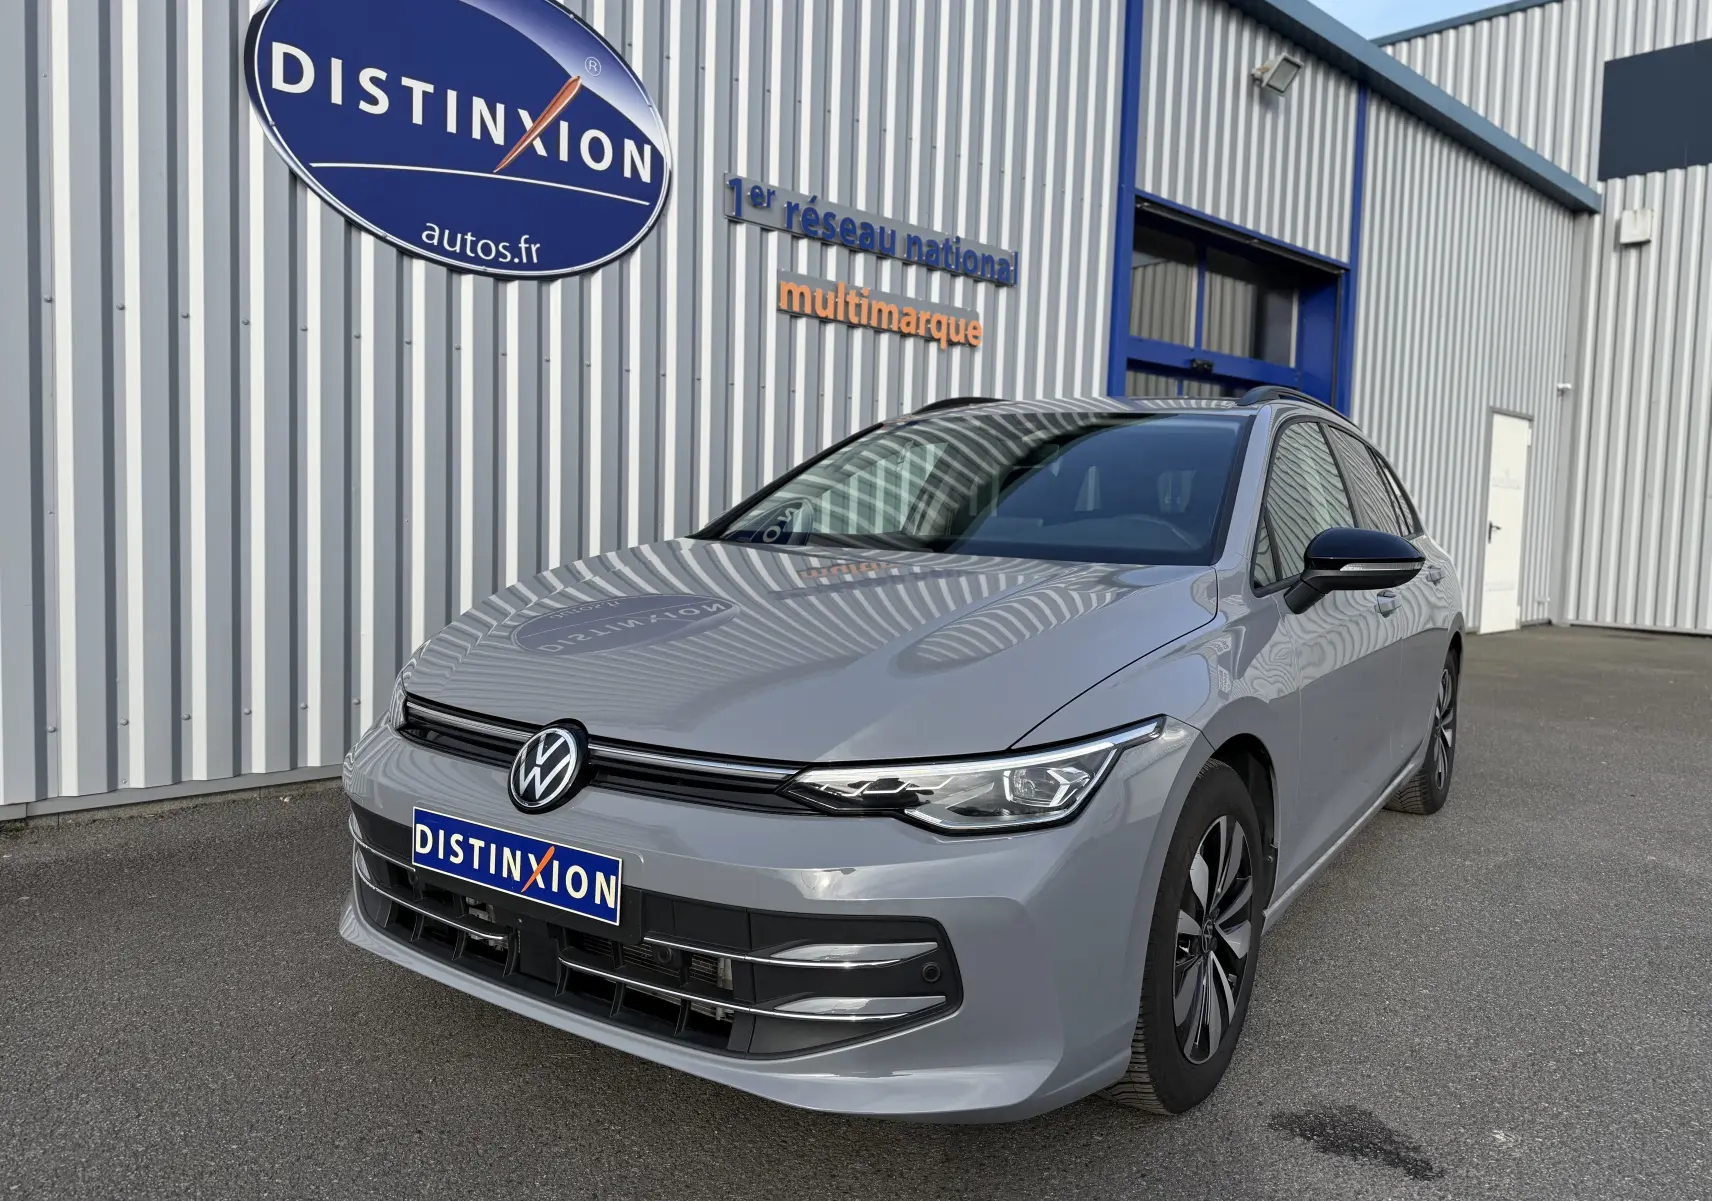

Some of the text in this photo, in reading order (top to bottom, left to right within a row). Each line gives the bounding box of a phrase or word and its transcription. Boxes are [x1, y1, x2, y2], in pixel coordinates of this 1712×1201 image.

[271, 41, 652, 184] DISTINXION
[421, 221, 541, 264] autos.fr
[785, 195, 897, 256] réseau
[906, 231, 1019, 286] national
[779, 280, 983, 350] multimarque
[415, 823, 617, 909] DISTINXION
